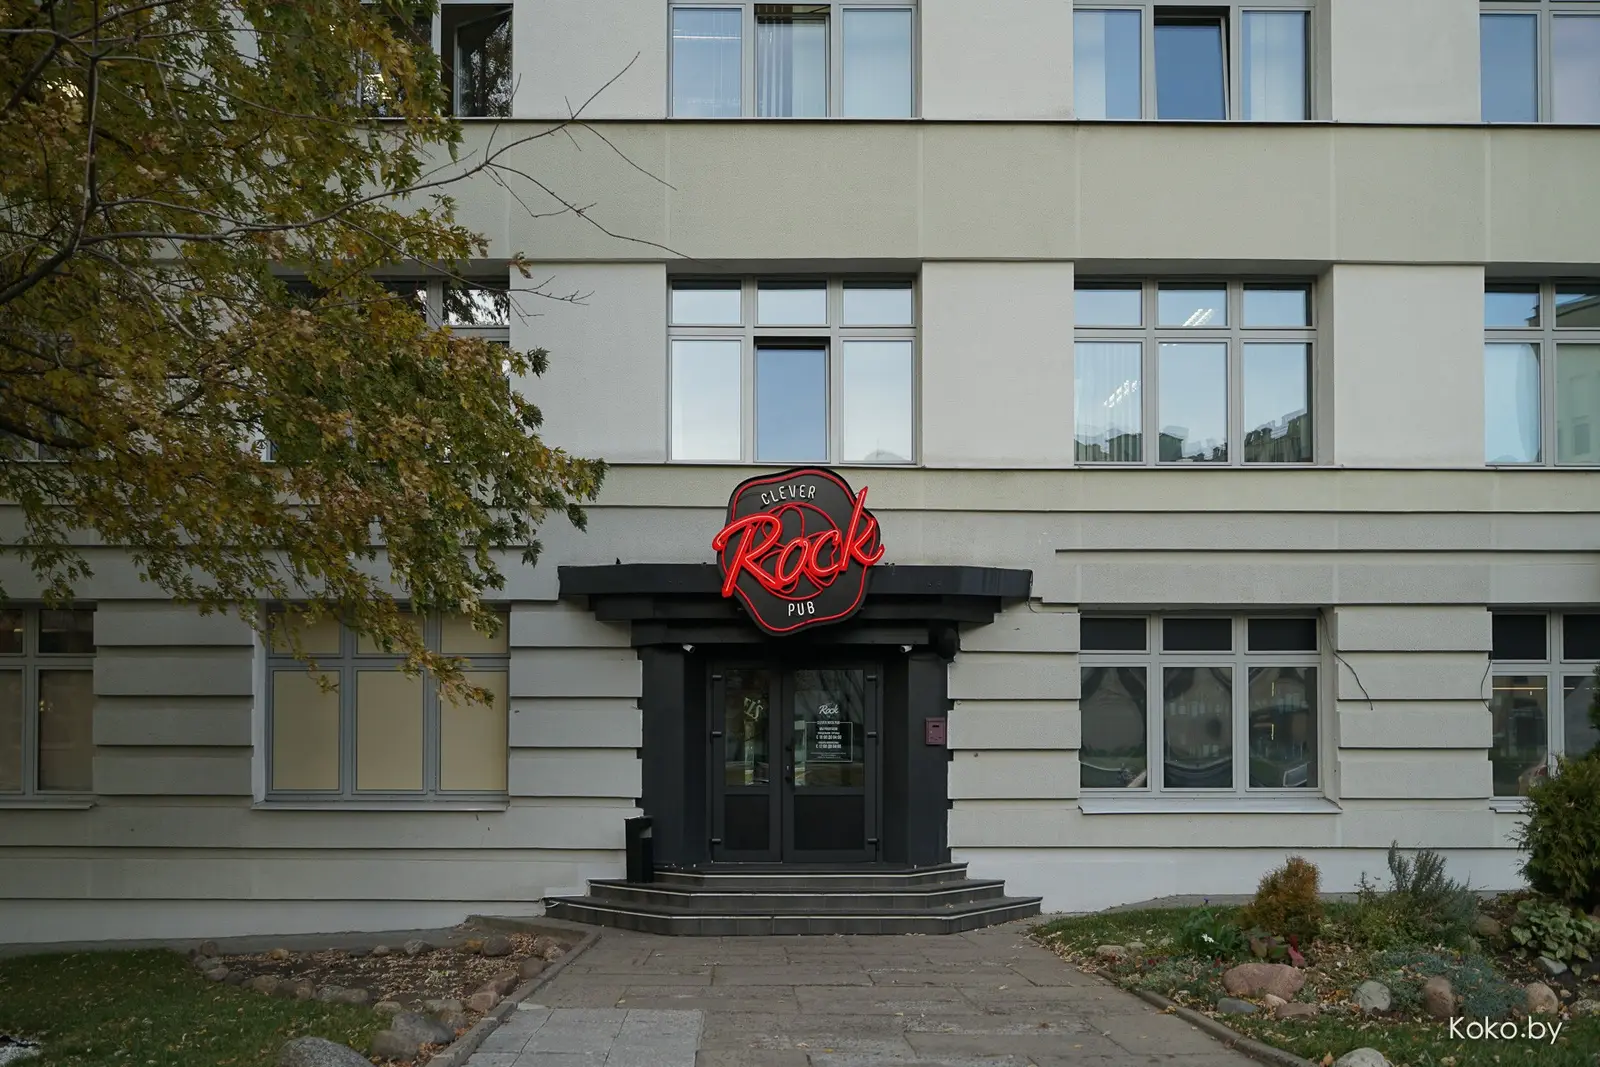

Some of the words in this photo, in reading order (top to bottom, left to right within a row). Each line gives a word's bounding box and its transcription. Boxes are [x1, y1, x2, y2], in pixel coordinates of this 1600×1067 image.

[760, 485, 817, 505] CLEVER
[712, 486, 886, 598] Rock
[788, 601, 815, 617] PUB
[818, 704, 839, 715] Rock
